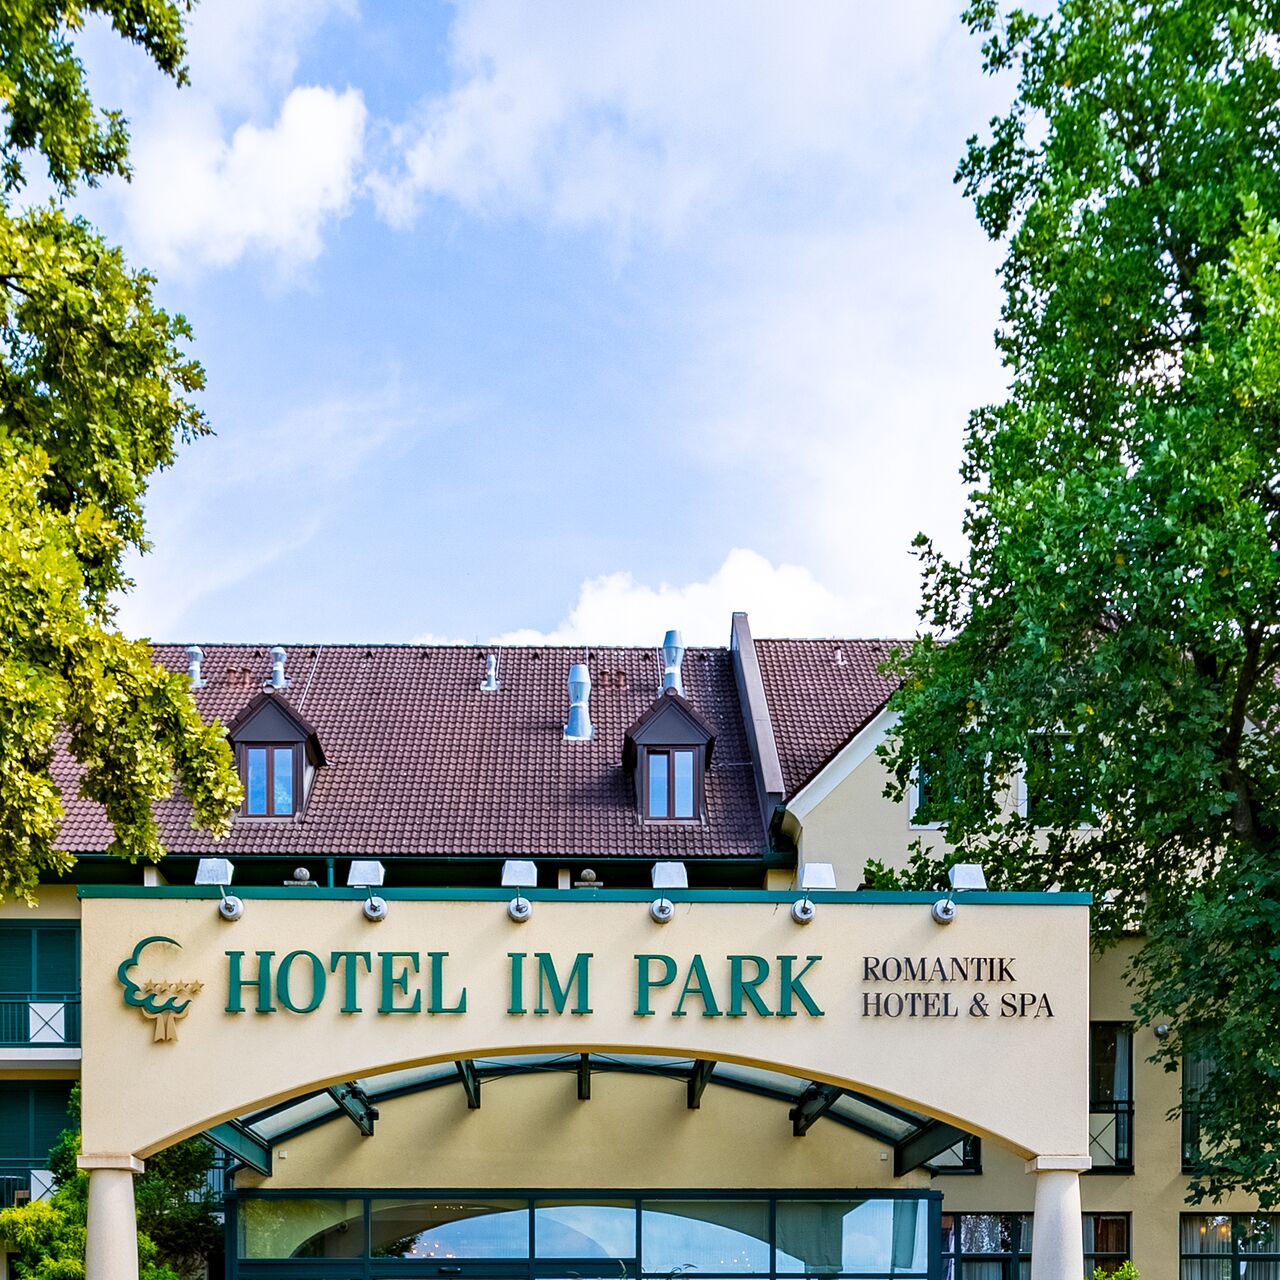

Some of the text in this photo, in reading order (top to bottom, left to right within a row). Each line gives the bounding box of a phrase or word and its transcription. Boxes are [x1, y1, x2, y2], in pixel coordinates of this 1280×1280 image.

[862, 956, 1017, 982] ROMANTIK
[224, 950, 825, 1018] HOTEL IM PARK
[862, 992, 1054, 1018] HOTEL & SPA
